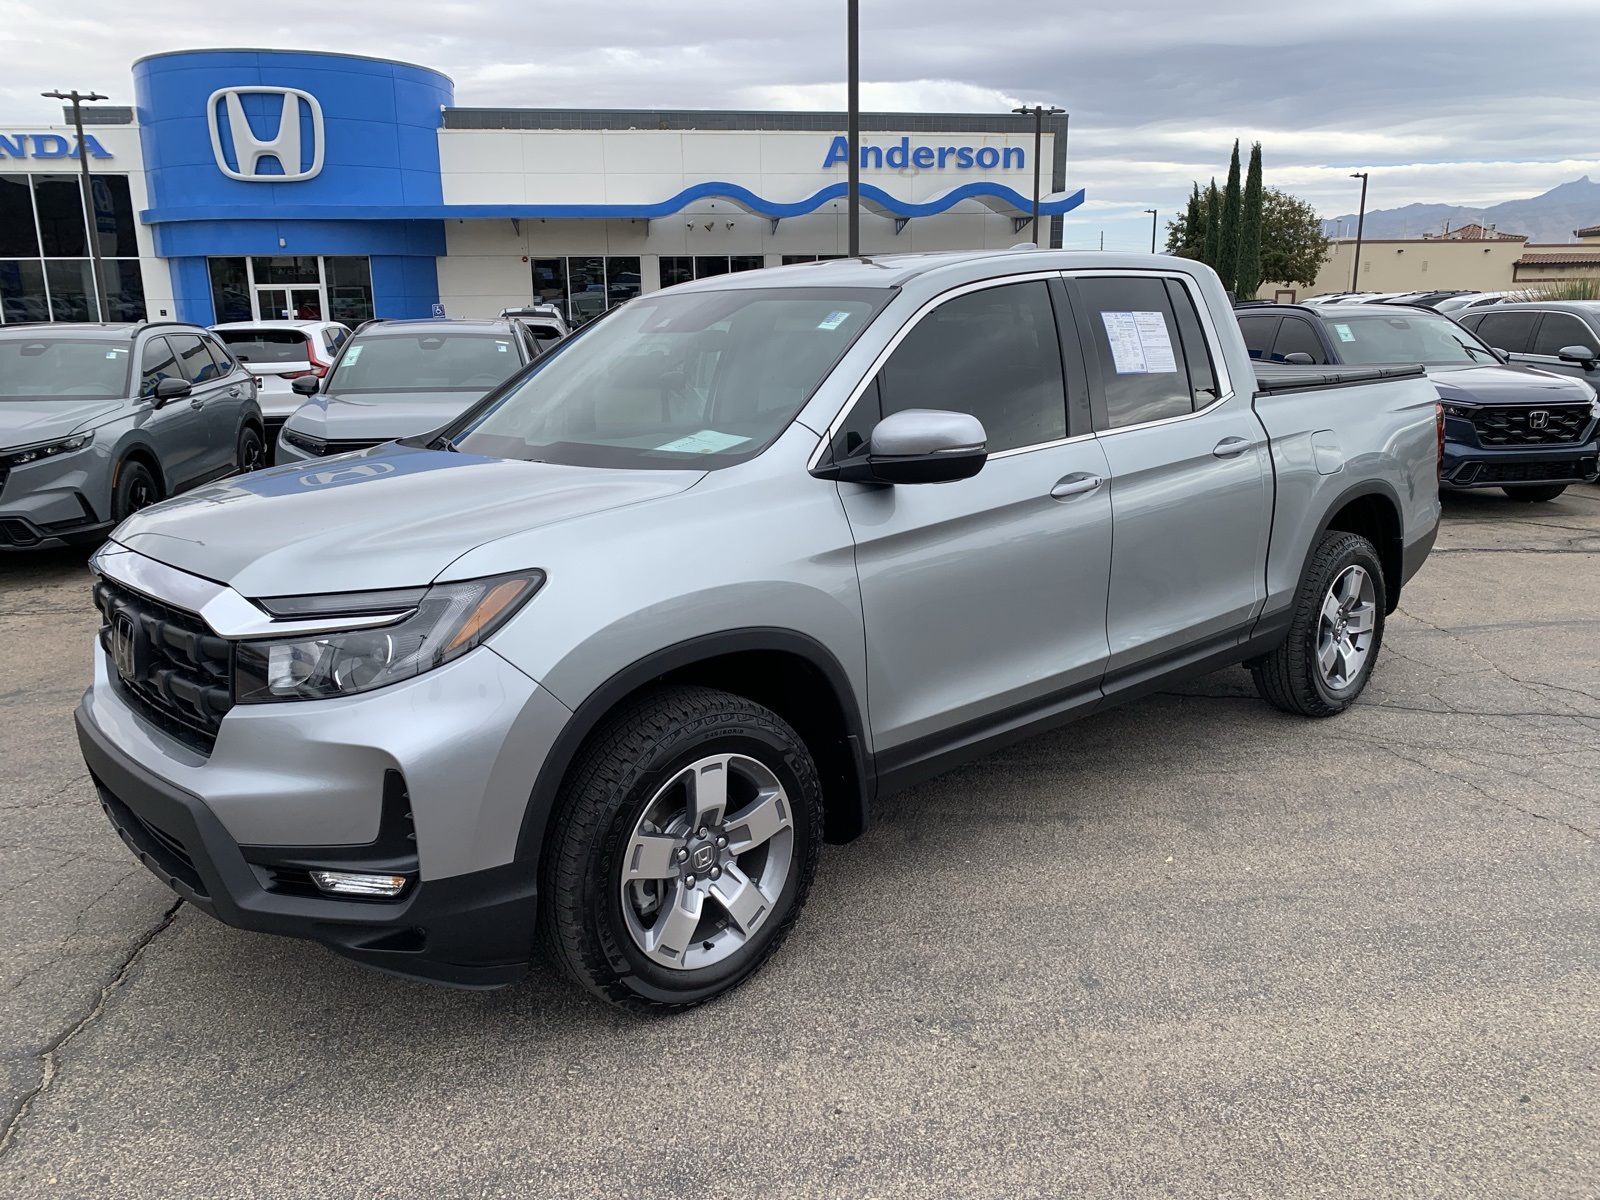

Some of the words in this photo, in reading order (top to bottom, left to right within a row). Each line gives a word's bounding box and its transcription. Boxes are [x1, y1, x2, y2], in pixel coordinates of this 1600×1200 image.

[0, 134, 113, 158] NDA
[823, 136, 1025, 169] Anderson
[276, 267, 331, 275] WELCOE
